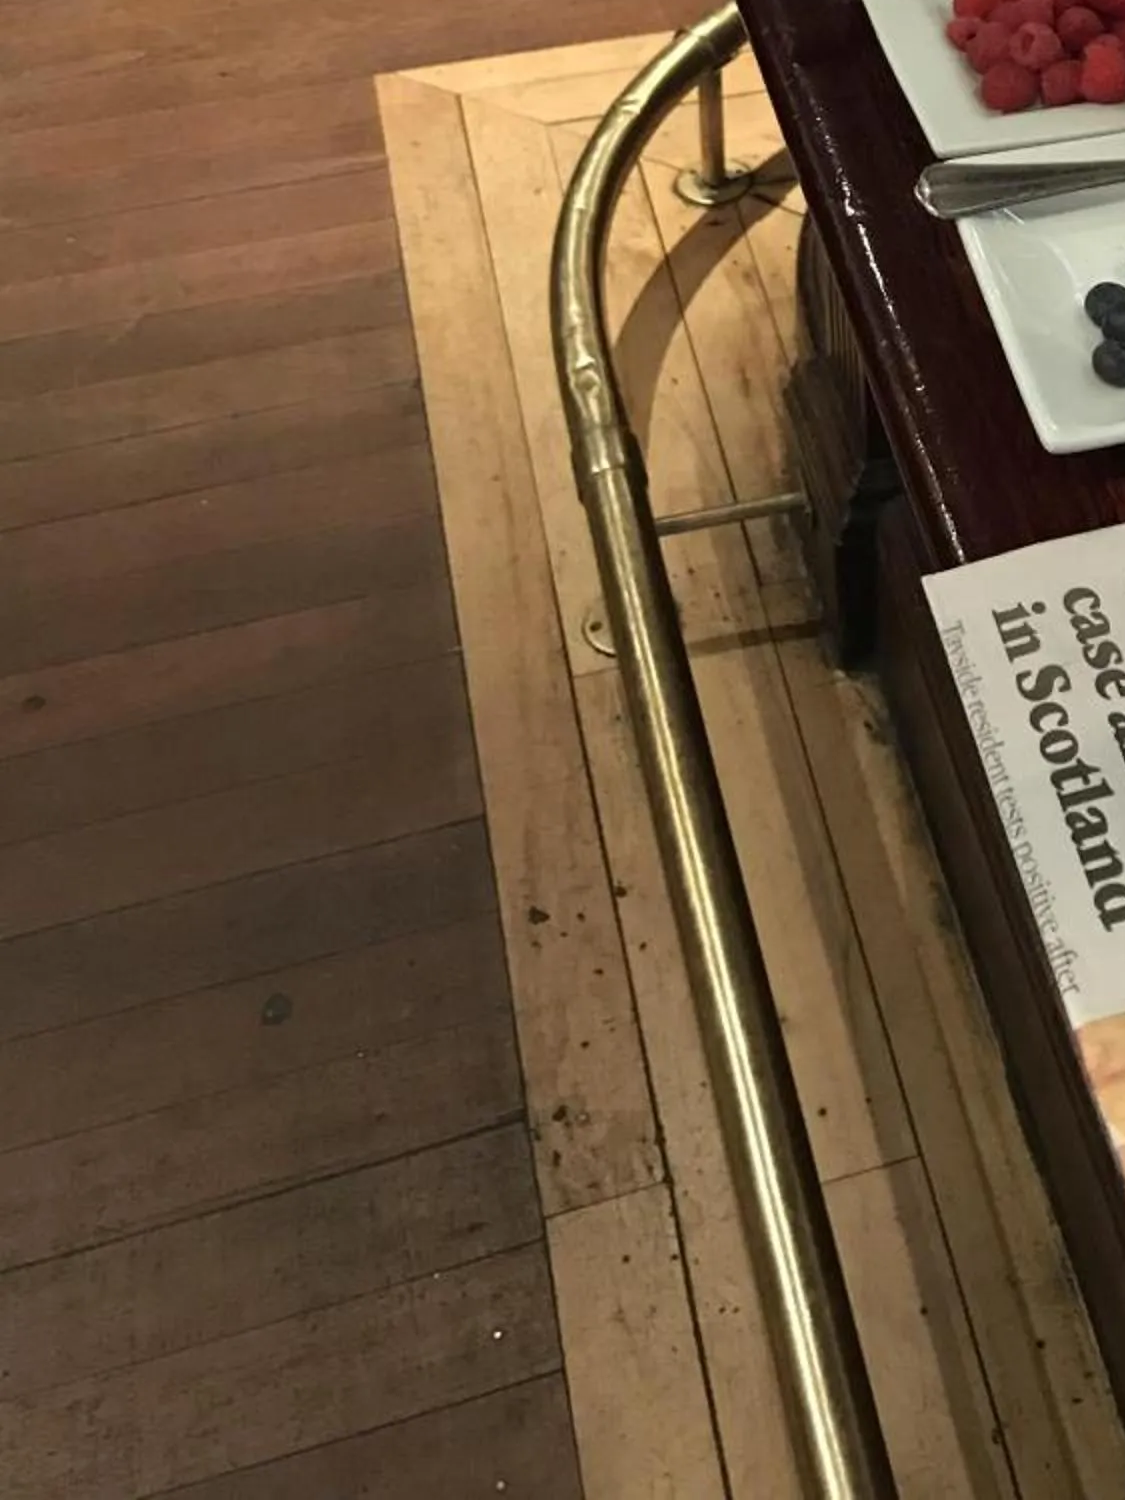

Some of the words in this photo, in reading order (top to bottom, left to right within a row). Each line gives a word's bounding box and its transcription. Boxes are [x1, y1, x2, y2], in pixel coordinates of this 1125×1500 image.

[991, 601, 1047, 664] in
[942, 619, 983, 697] Tayside
[967, 699, 1010, 786] resident
[995, 786, 1027, 839] tests
[1013, 840, 1059, 935] positive
[1045, 936, 1083, 997] after
